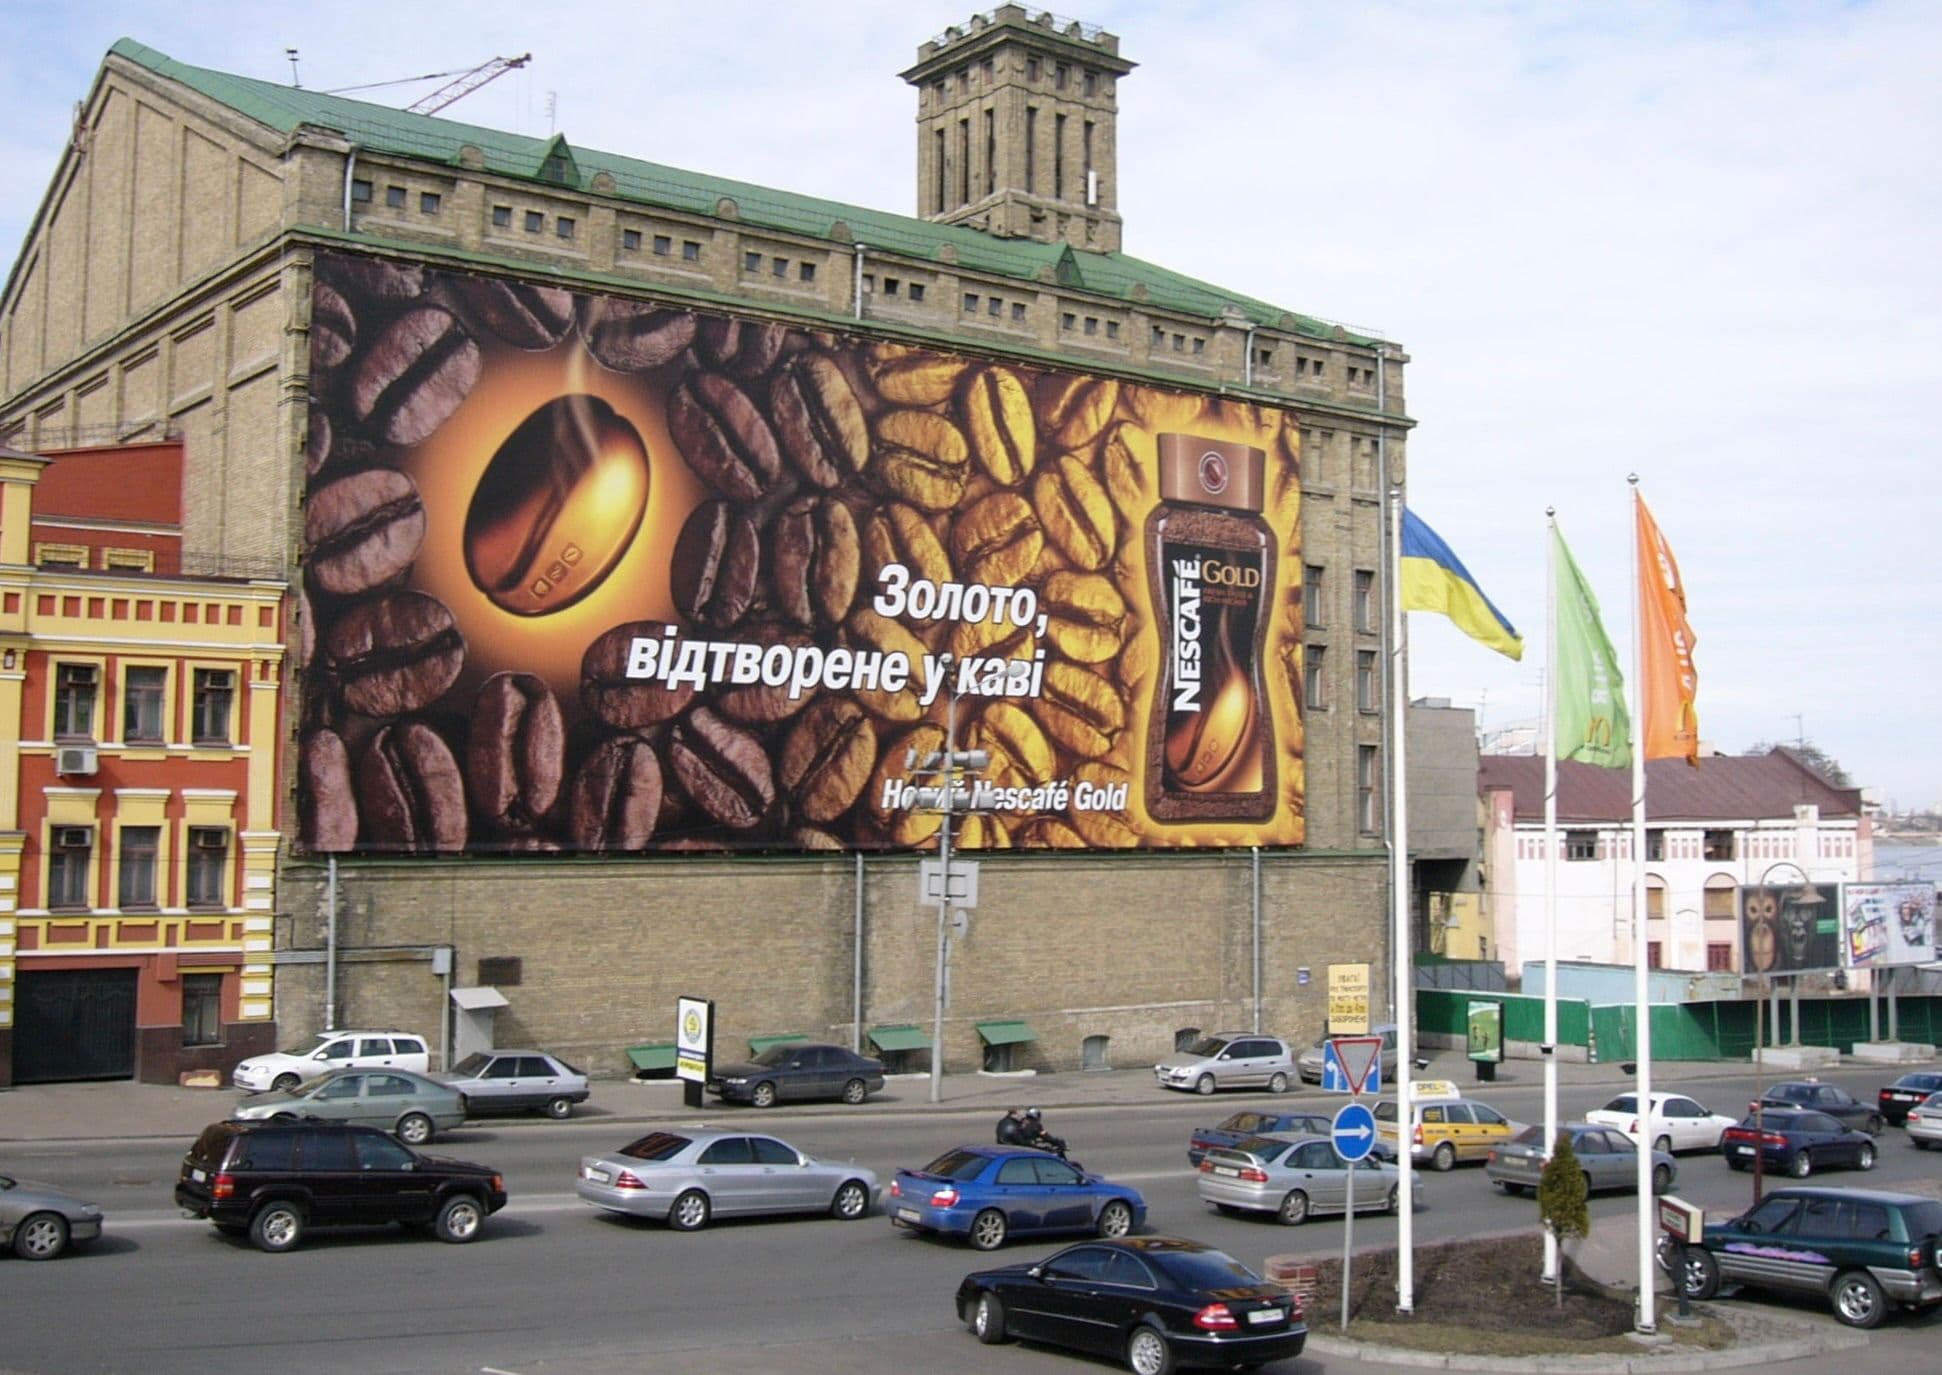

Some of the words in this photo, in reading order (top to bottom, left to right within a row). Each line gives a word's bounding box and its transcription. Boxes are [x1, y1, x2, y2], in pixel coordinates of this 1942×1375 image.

[873, 562, 1050, 638] Золото,
[625, 625, 910, 699] відтворене
[956, 648, 1046, 698] каві
[1074, 782, 1129, 812] Gold
